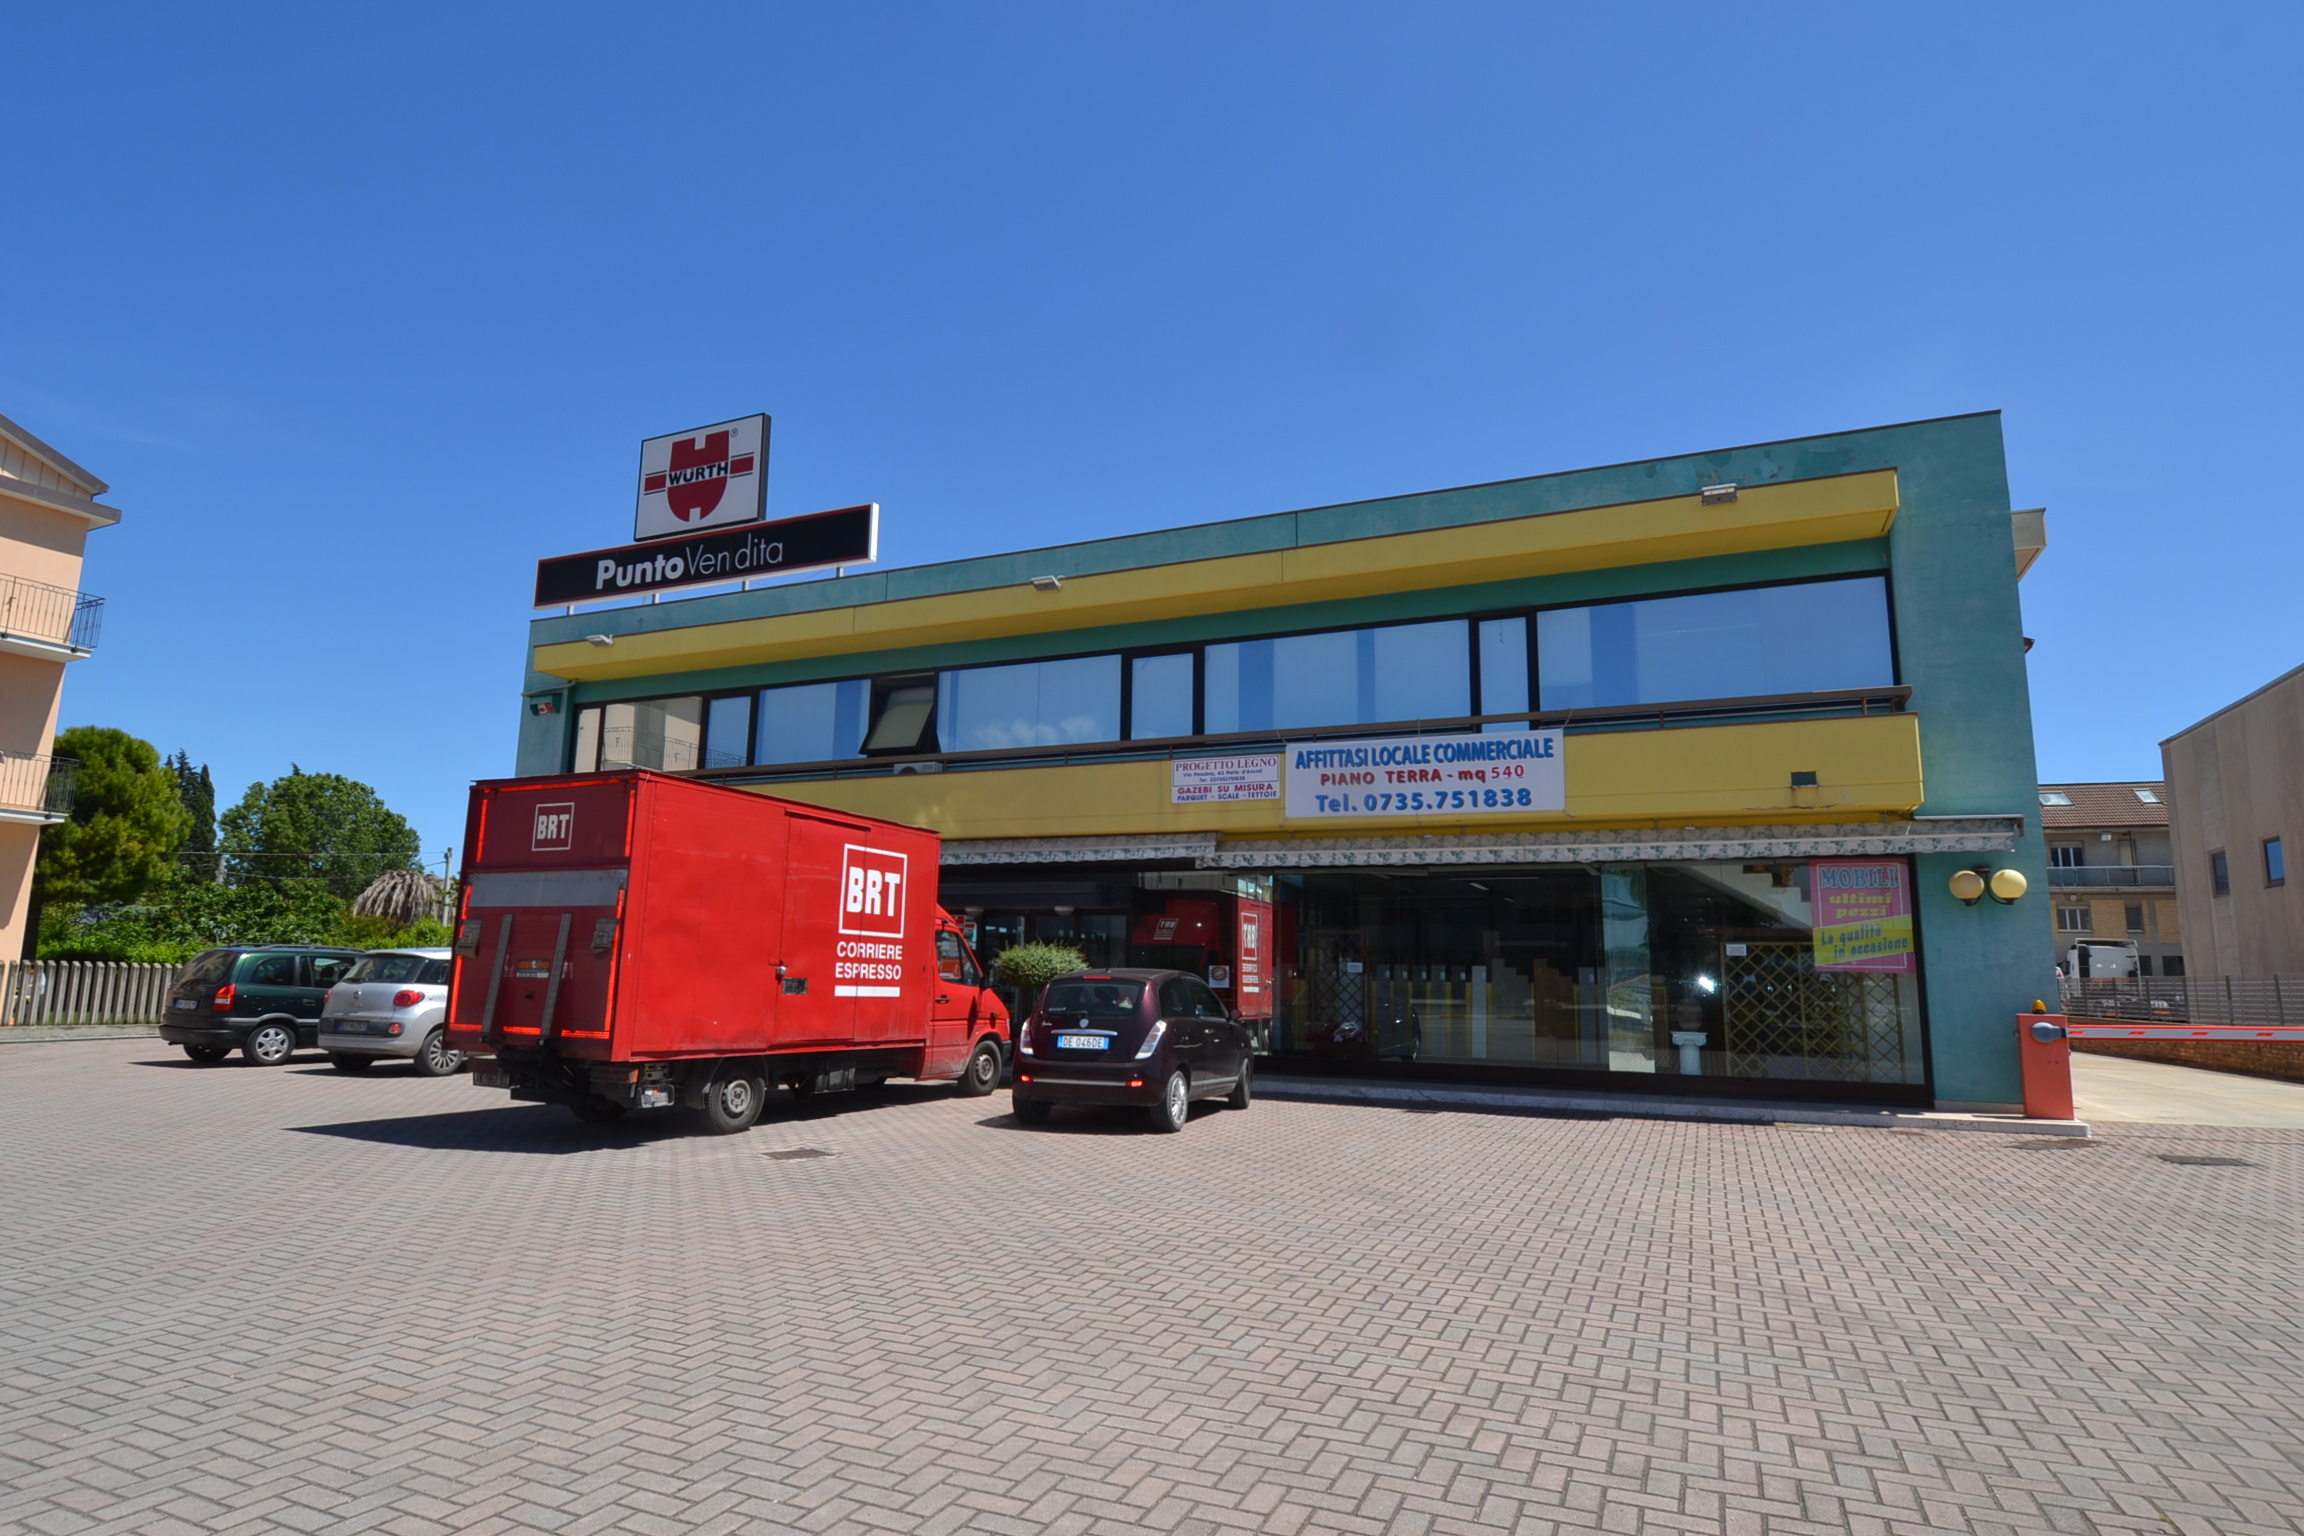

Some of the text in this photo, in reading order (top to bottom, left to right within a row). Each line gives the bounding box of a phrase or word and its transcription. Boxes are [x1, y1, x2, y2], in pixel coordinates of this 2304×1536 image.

[668, 461, 729, 486] WÜRTH
[1295, 737, 1554, 769] AFFITTASI LOCALE COMMERCIALE
[1176, 757, 1276, 772] PROGETTO LEGNO
[1320, 771, 1375, 786] PIANO
[1385, 768, 1442, 784] TERRA
[1458, 769, 1486, 783] mq
[1491, 764, 1524, 779] 540
[1177, 783, 1273, 795] GAZEBI SU MISURA
[1218, 792, 1239, 800] SCALE
[1248, 790, 1277, 799] TETTOIE
[1315, 788, 1532, 812] Tel. 0735.751838
[536, 813, 570, 840] BRT
[1820, 867, 1898, 889] MOBILI
[846, 866, 901, 917] BRT
[1829, 893, 1893, 905] ultimi
[1835, 905, 1888, 919] pezzi
[1840, 923, 1882, 946] qualità
[837, 941, 903, 960] CORRIERE
[1834, 937, 1908, 959] in occasione
[835, 962, 902, 980] ESPRESSO
